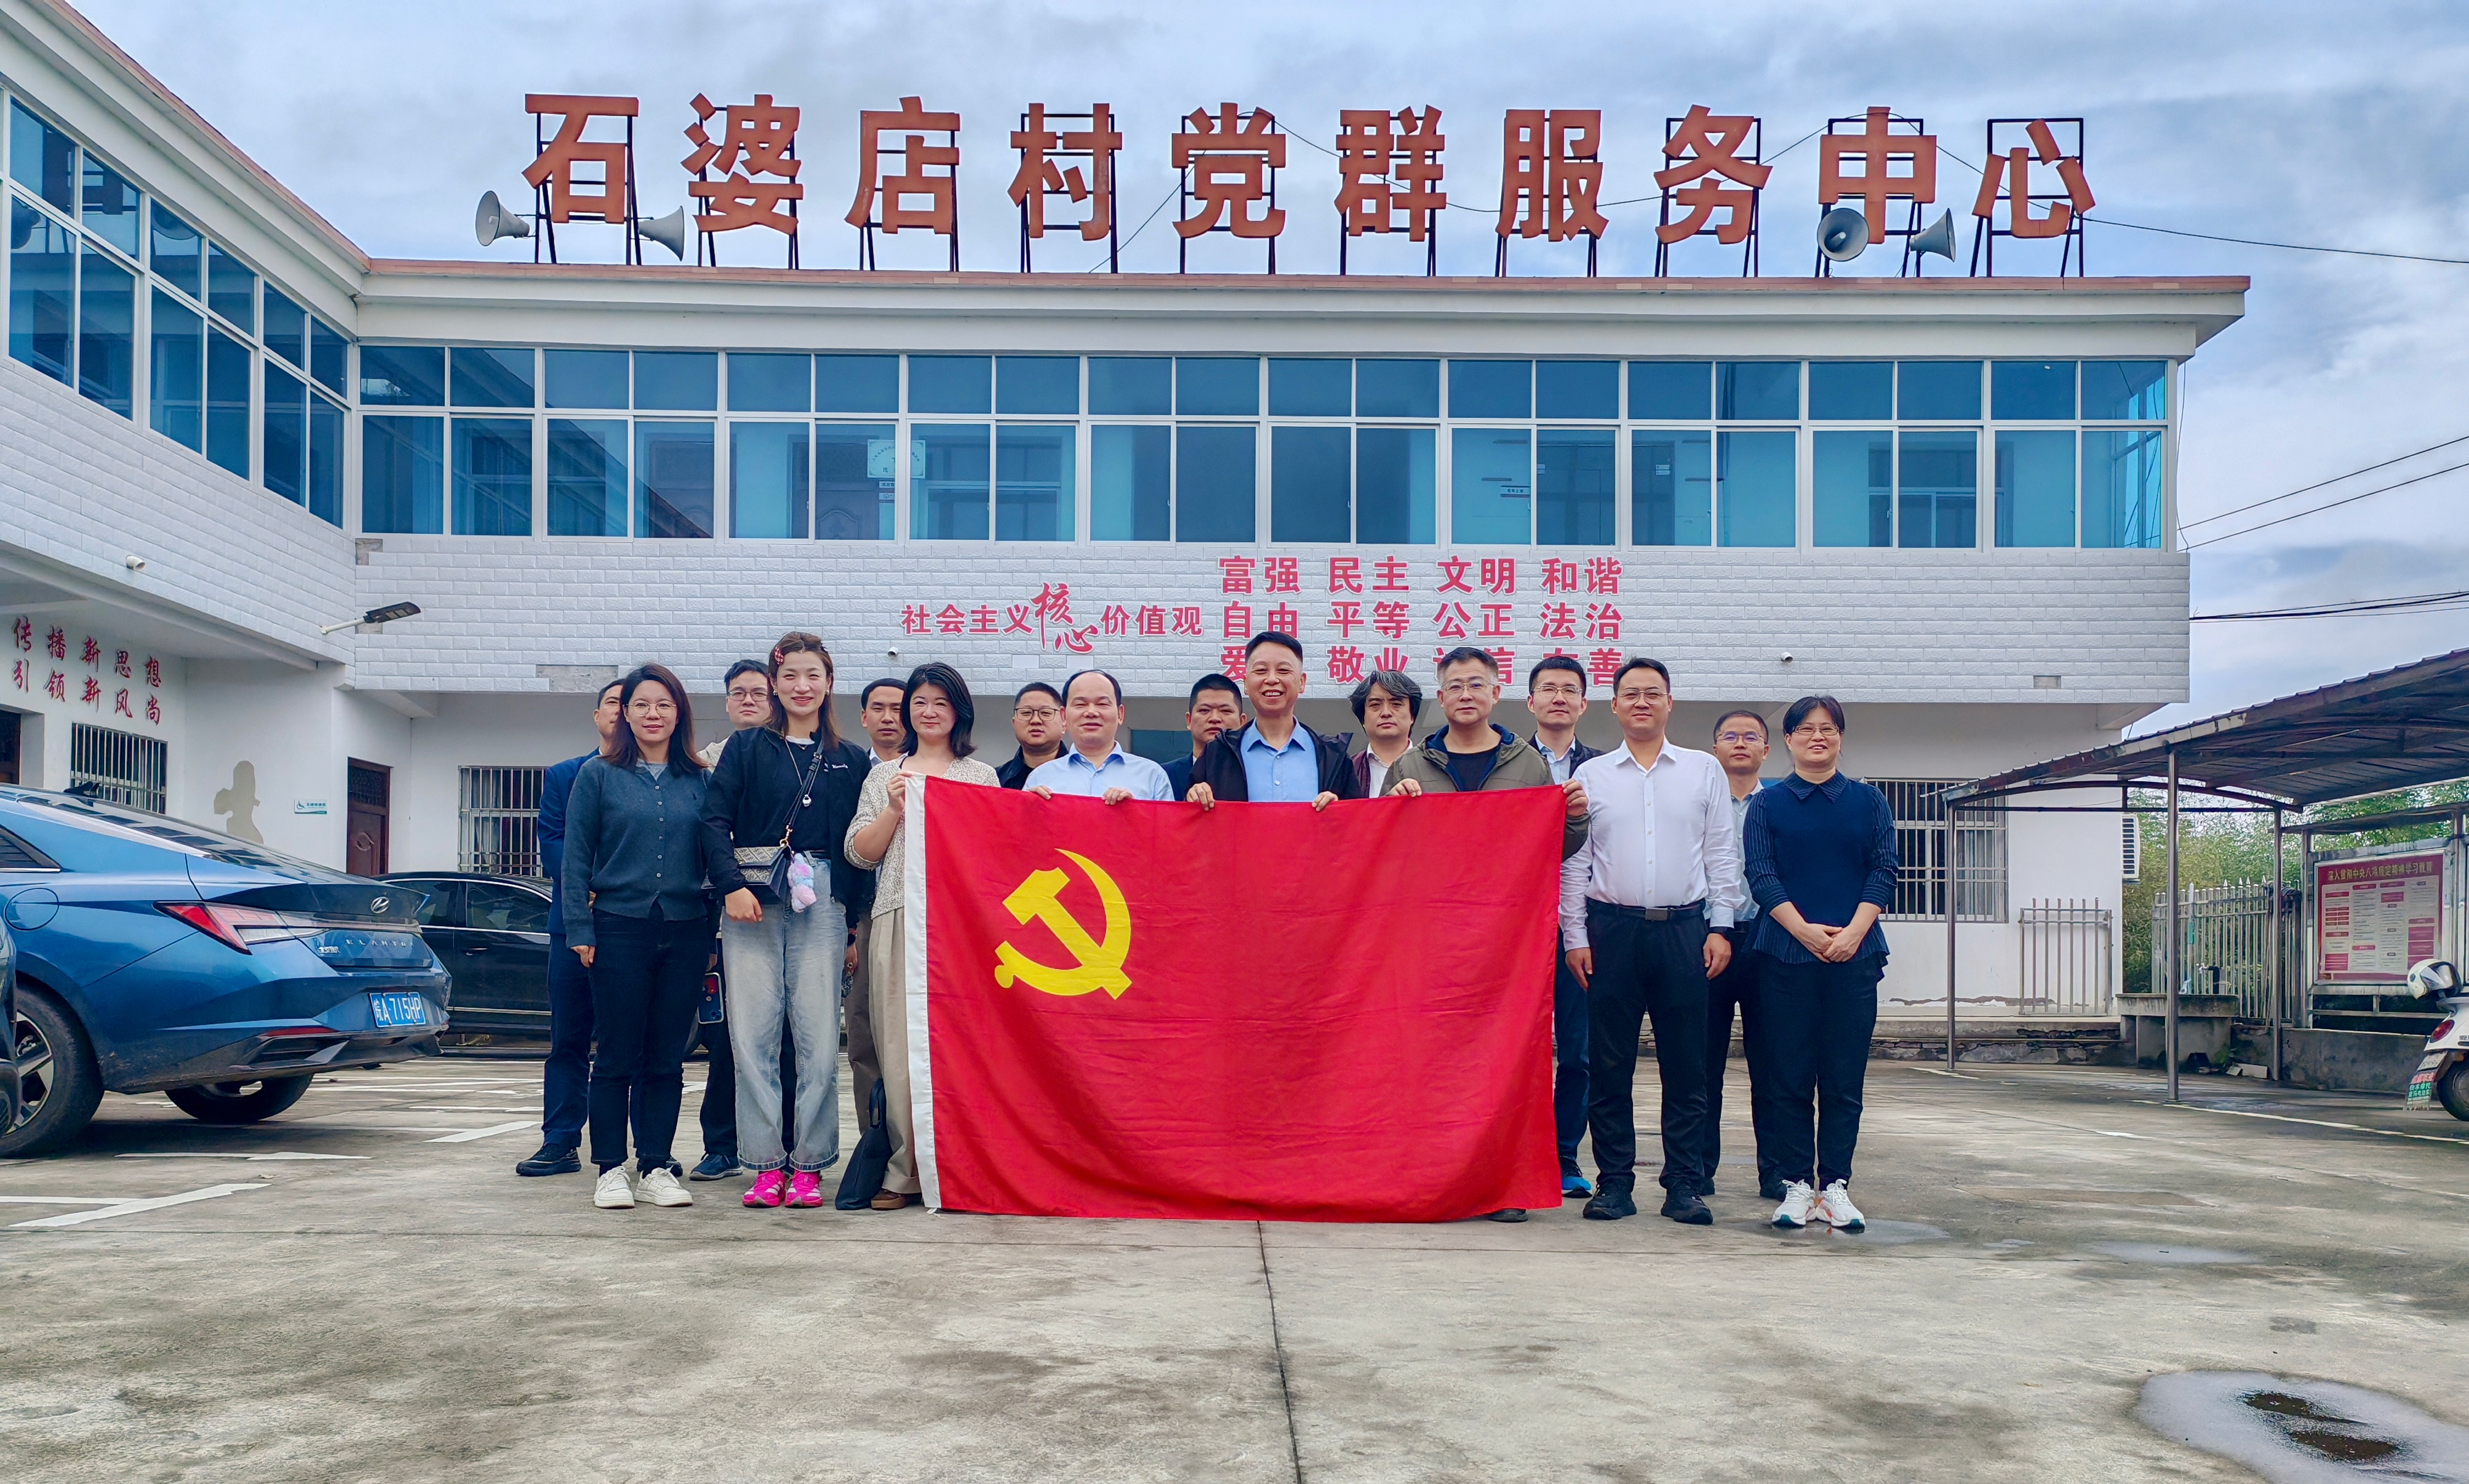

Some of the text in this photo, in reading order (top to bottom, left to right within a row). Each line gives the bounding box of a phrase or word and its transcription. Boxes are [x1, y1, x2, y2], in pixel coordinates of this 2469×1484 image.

[522, 92, 2095, 244] 石婆店村党群服务中心
[1219, 555, 1622, 596] 富强 民主 文明 和谐
[1224, 600, 1623, 641] 自由 平等 公正 法治
[14, 616, 161, 688] 传播新思想
[1327, 646, 1410, 684] 敬业
[1433, 647, 1517, 685] 信
[12, 658, 161, 726] 引领新风尚
